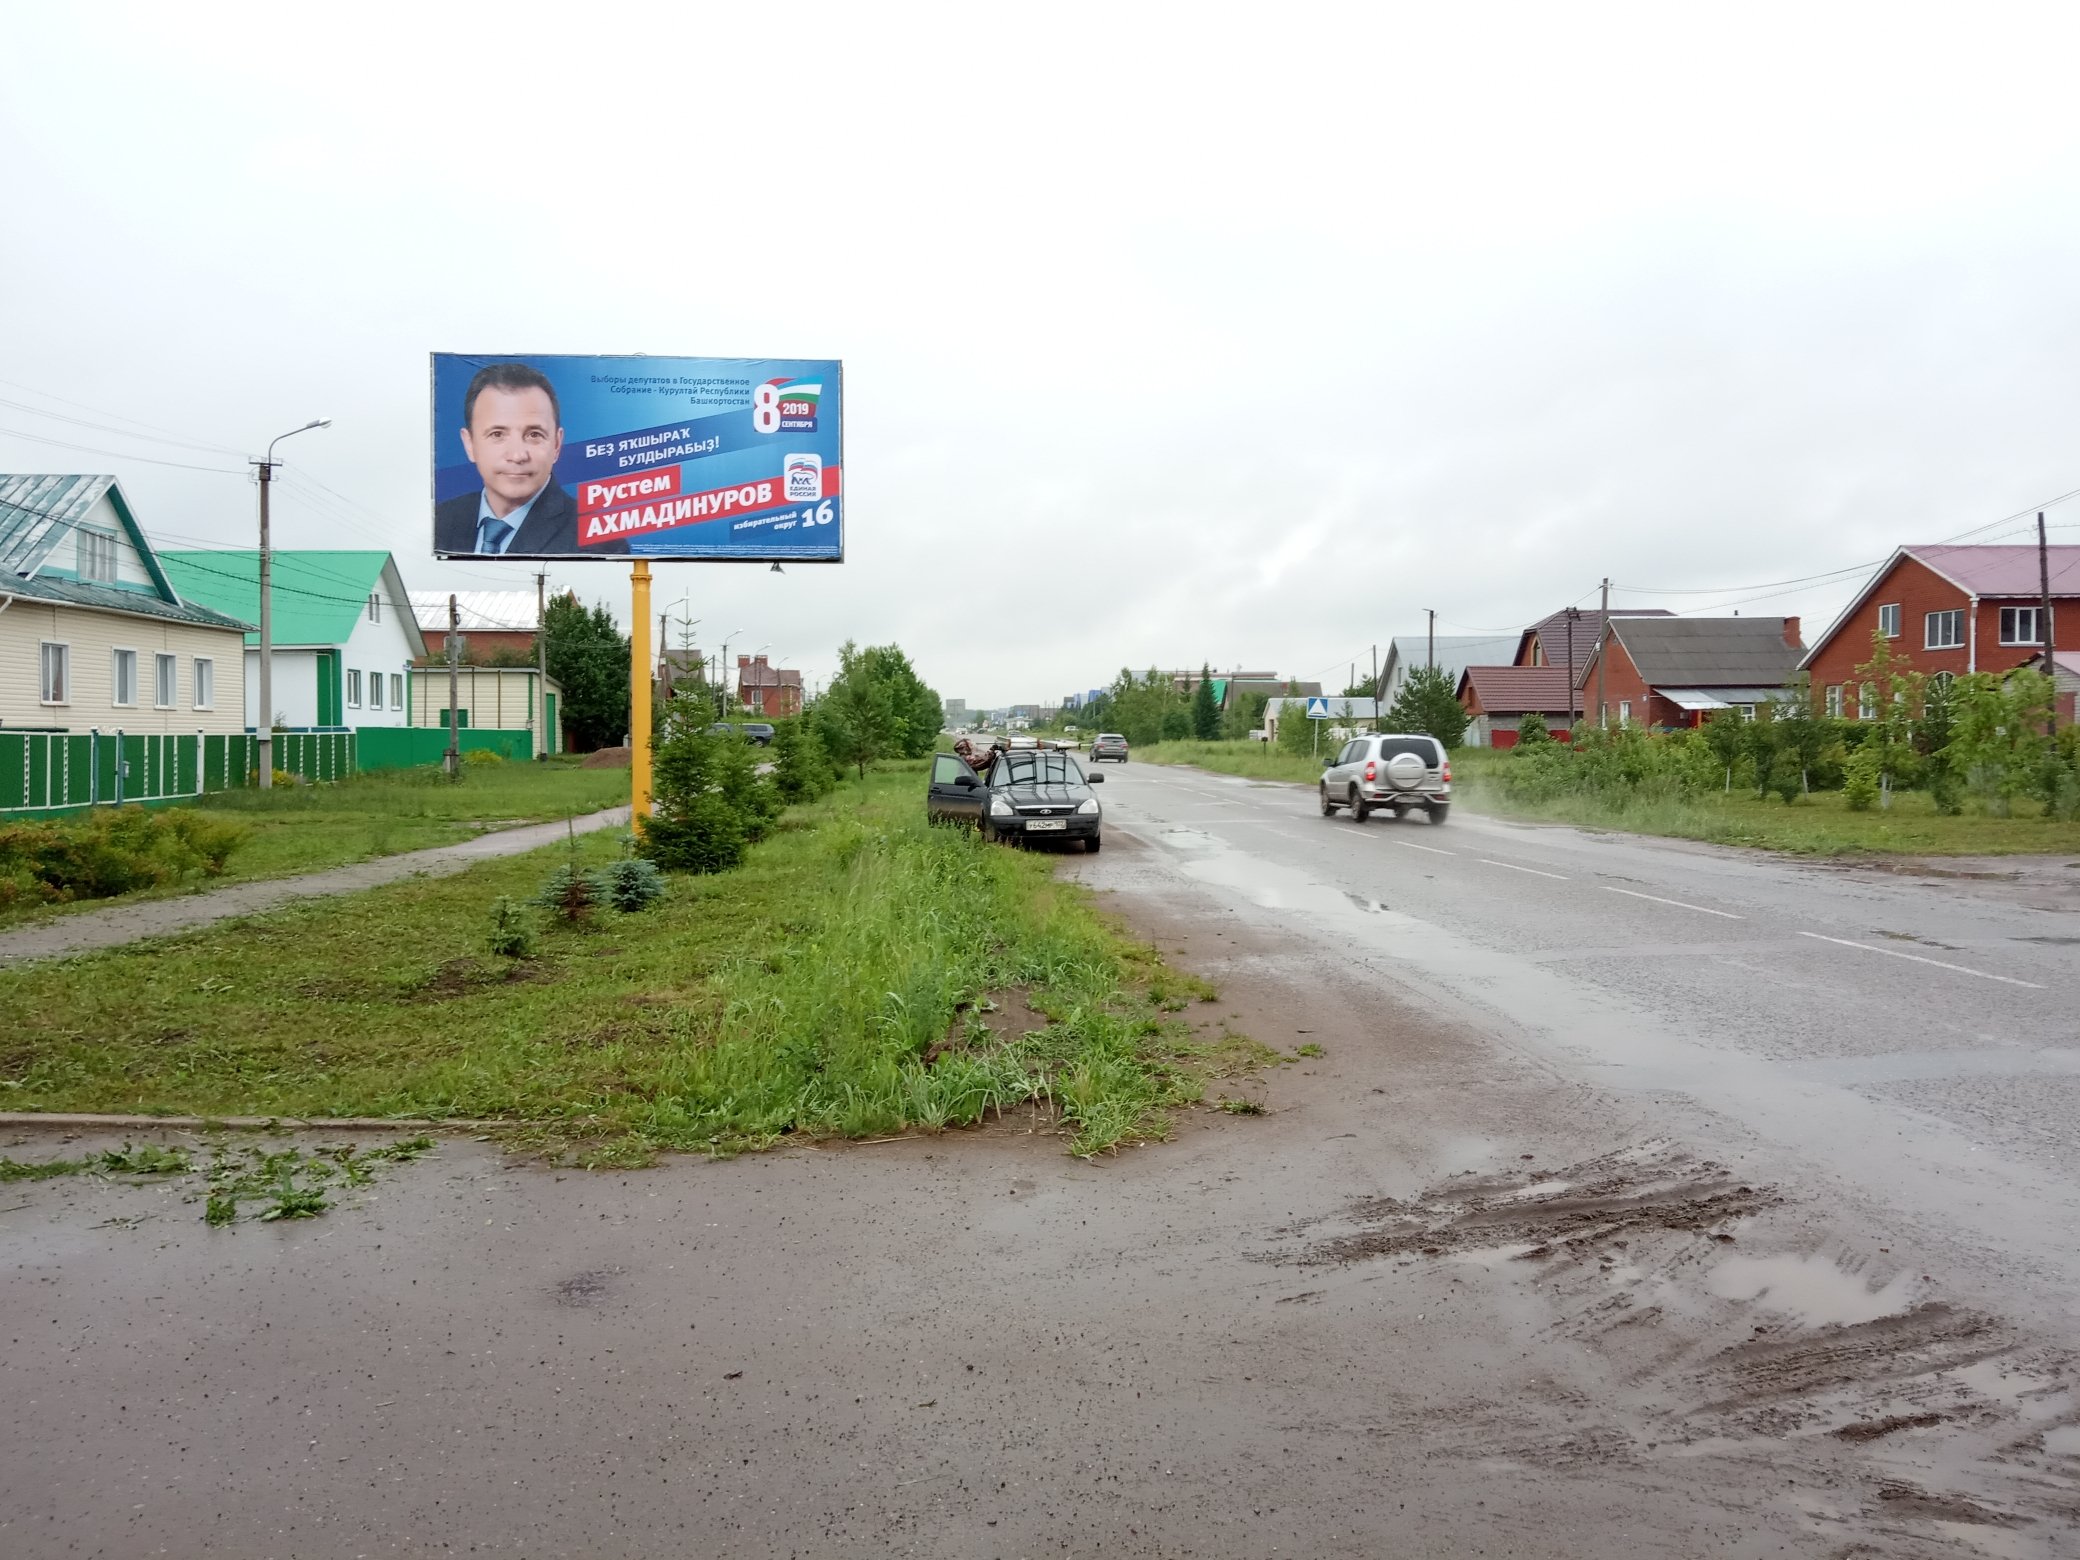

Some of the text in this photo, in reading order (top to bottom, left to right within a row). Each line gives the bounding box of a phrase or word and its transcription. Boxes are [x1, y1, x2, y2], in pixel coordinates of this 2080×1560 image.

[591, 375, 626, 385] Выборы
[628, 376, 670, 386] депутатов
[680, 377, 750, 386] Государственное
[610, 385, 652, 395] Собрание
[659, 386, 697, 396] Курултай
[700, 387, 750, 397] Республики
[690, 396, 750, 406] Башкортостан
[753, 383, 781, 434] 8
[782, 403, 809, 415] 2019
[781, 420, 813, 428] СЕНТЯБРЯ
[587, 475, 671, 508] Рустем
[586, 483, 772, 538] АХМАДИНУРОВ
[801, 499, 834, 528] 16
[733, 511, 798, 530] избирательный
[773, 519, 798, 530] округ
